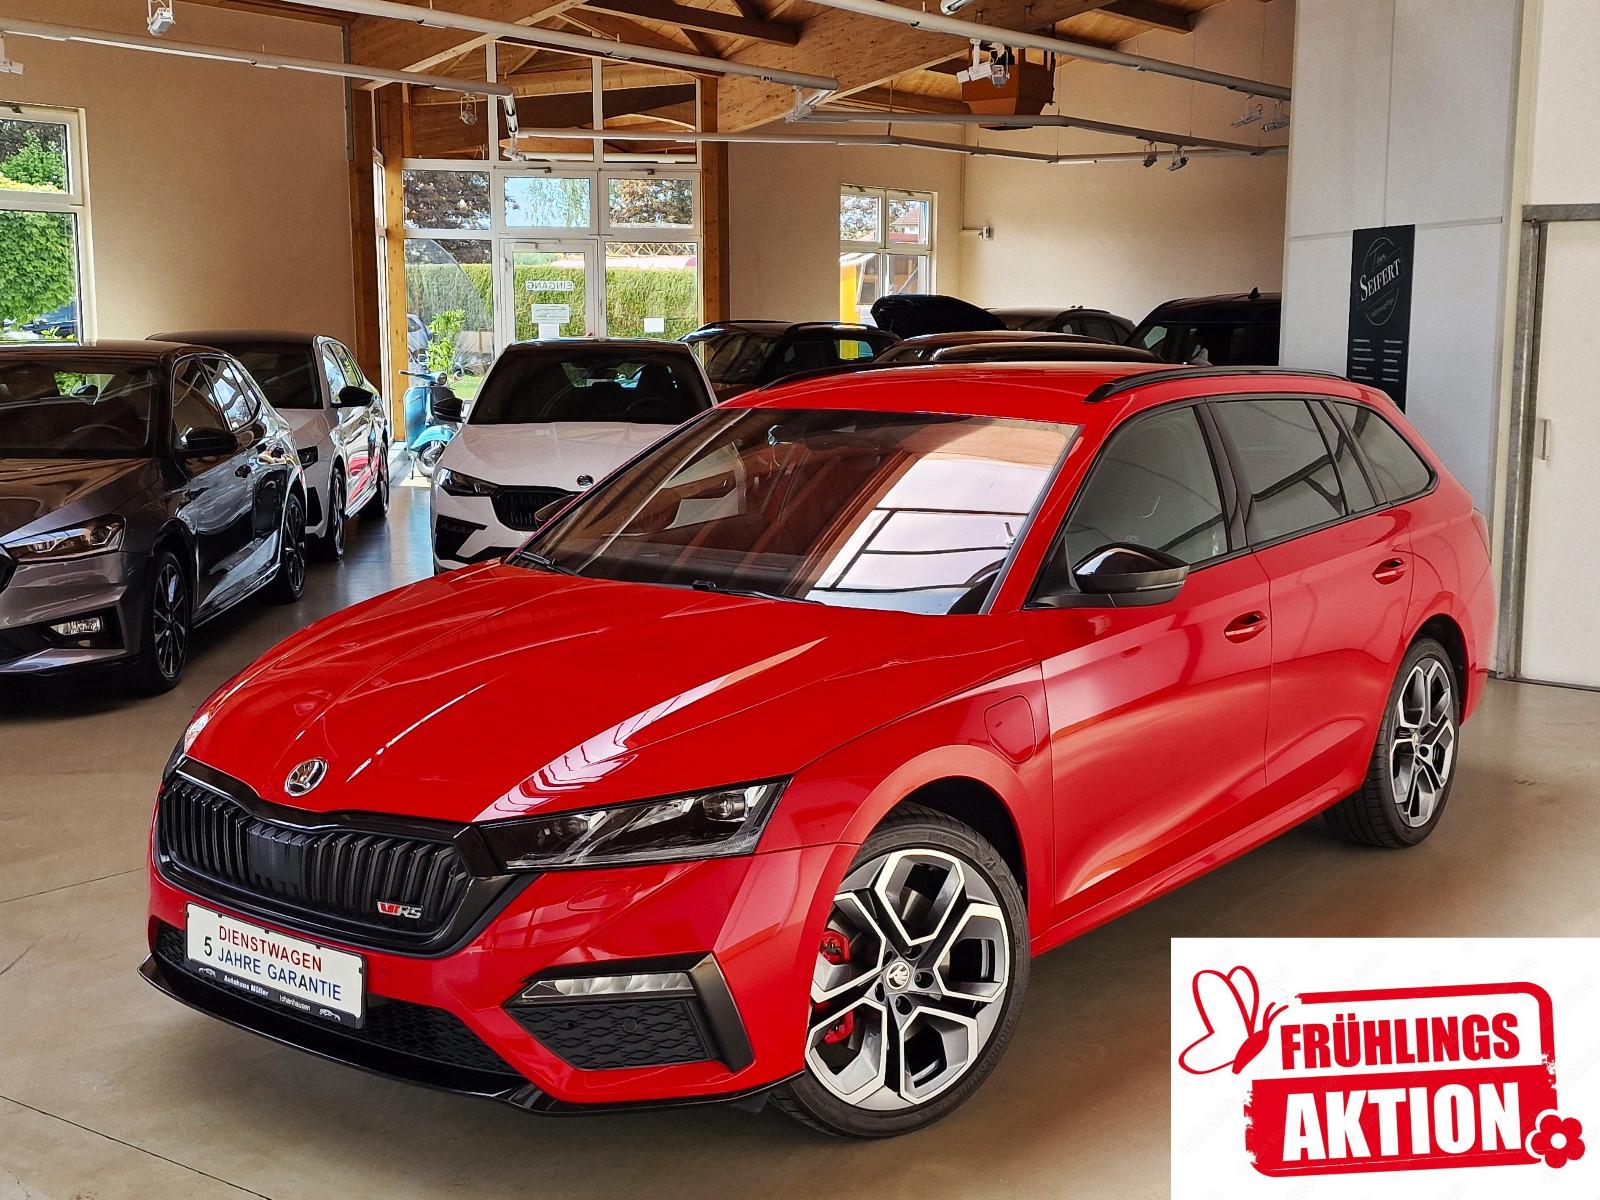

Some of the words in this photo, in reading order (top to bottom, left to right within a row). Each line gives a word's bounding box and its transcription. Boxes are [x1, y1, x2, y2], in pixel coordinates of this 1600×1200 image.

[1359, 258, 1401, 302] SEIFERT
[204, 935, 213, 957] 5
[218, 946, 262, 975] JAHRE
[267, 962, 342, 1001] GARANTIE
[218, 925, 322, 973] DIENSTWAGEN
[223, 974, 250, 990] Autohaus
[250, 984, 269, 997] Müller
